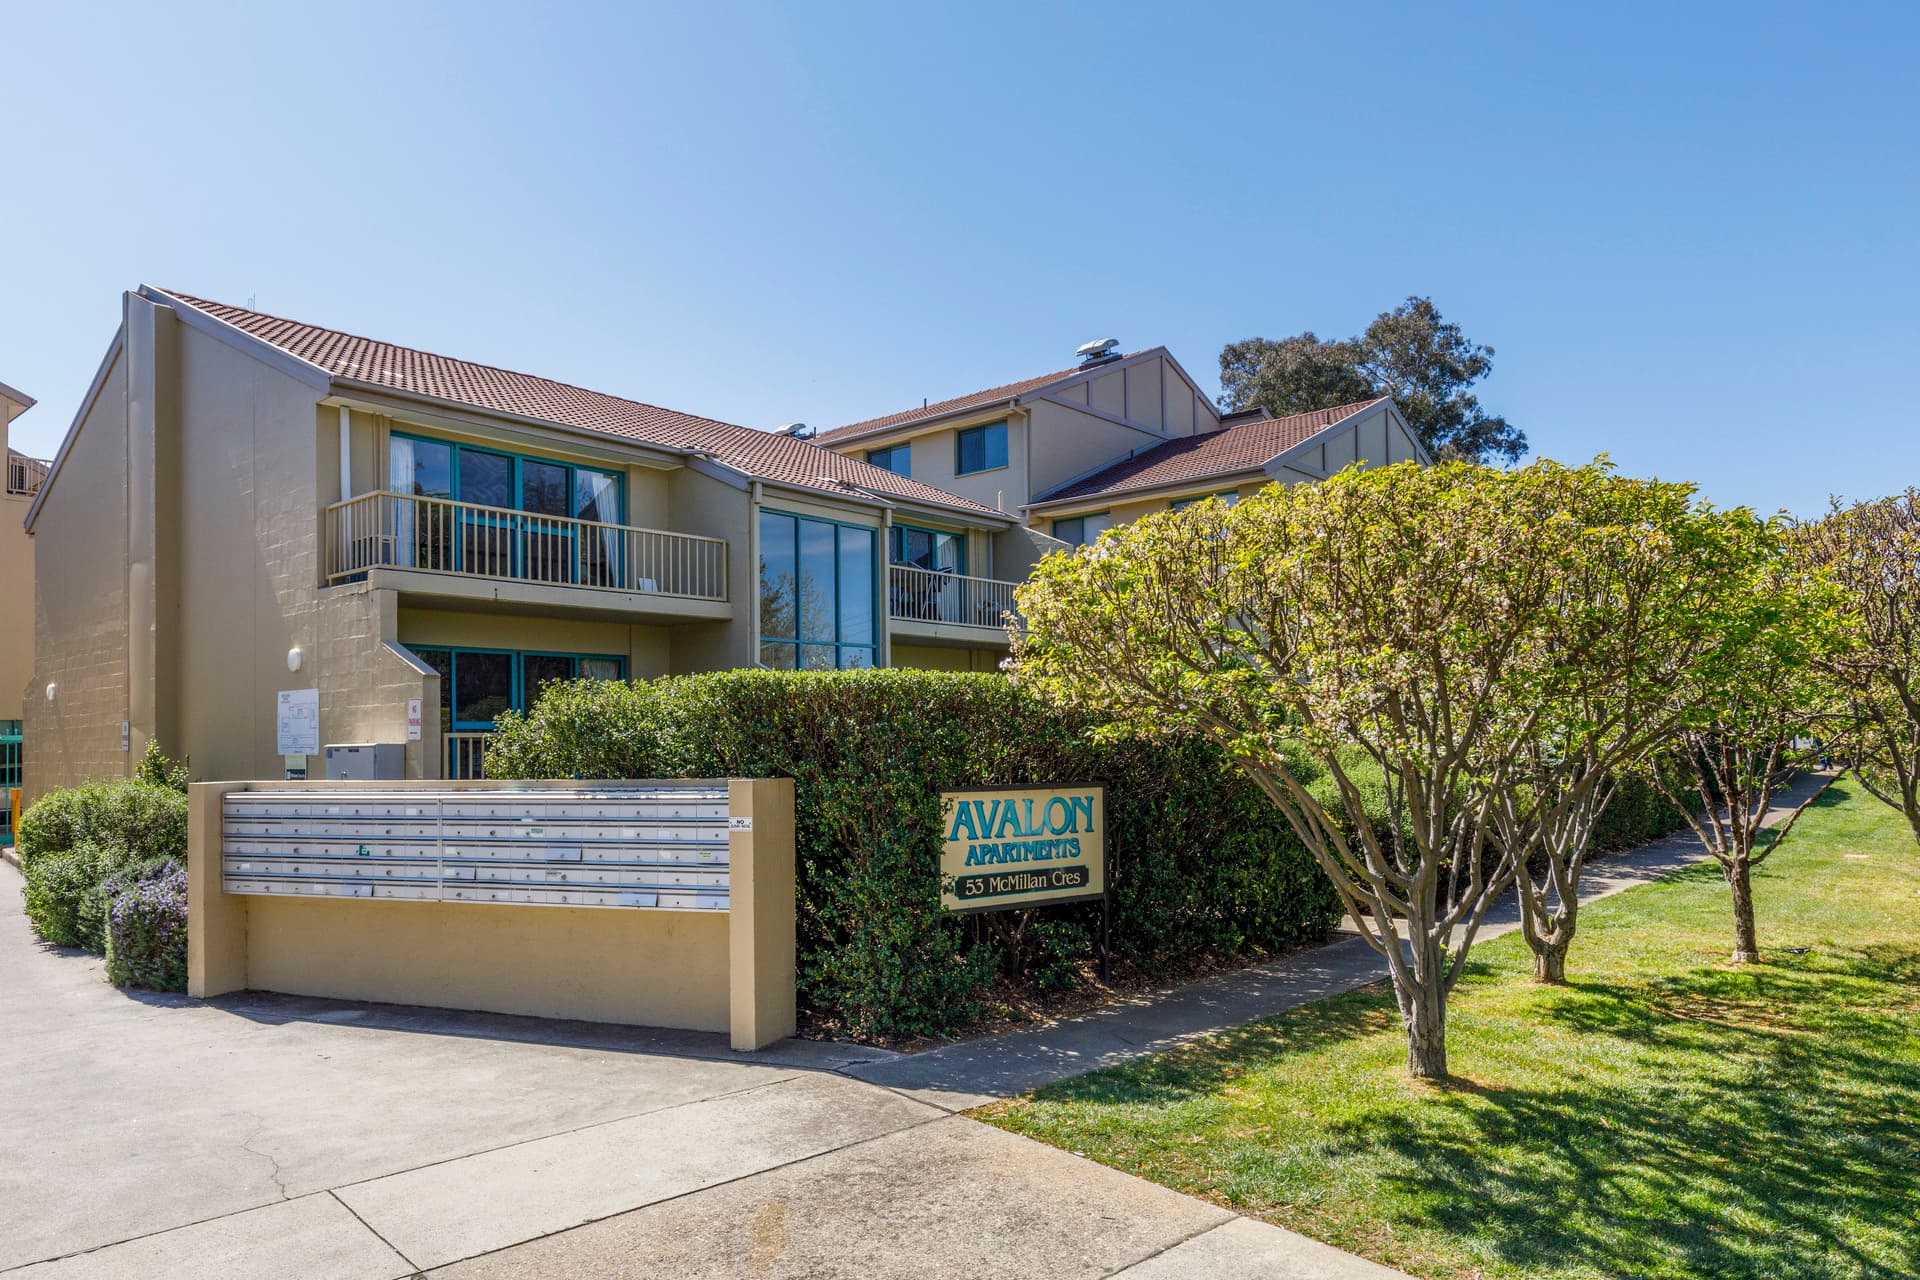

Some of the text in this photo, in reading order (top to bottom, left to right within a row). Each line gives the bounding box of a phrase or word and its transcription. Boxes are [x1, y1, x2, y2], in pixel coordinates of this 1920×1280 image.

[947, 796, 1095, 841] AVALON
[965, 837, 1081, 867] APARTMENTS
[965, 871, 1081, 896] 53 McMillan Cres
